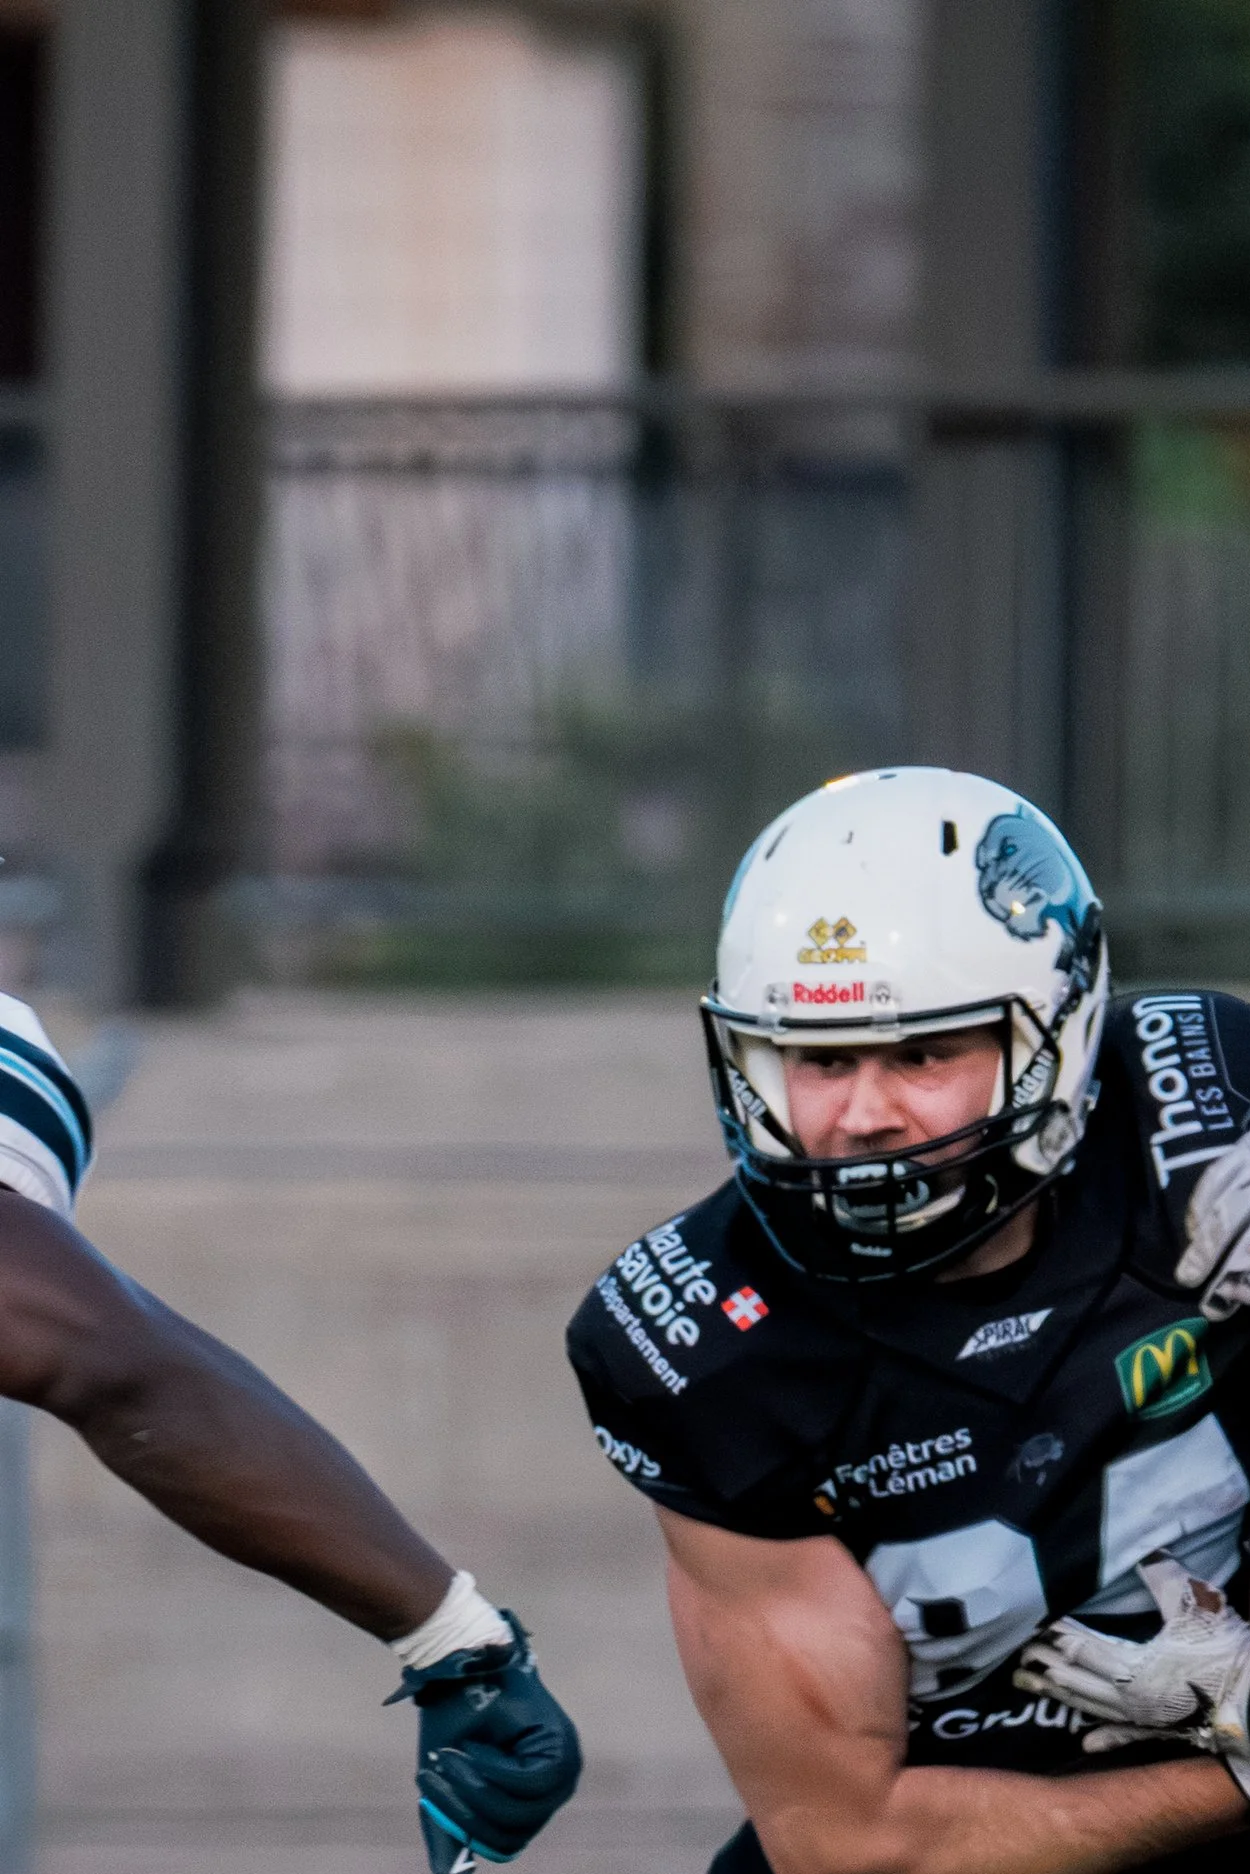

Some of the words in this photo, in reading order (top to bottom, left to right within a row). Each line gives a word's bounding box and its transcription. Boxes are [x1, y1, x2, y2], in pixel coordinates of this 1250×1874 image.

[792, 981, 864, 1005] Riddell
[1180, 1012, 1216, 1079] BAINS
[1132, 995, 1237, 1189] Thonon
[1198, 1086, 1234, 1131] LES
[616, 1242, 700, 1347] savoie
[834, 1427, 972, 1484] Fenêtres
[868, 1453, 977, 1498] Léman
